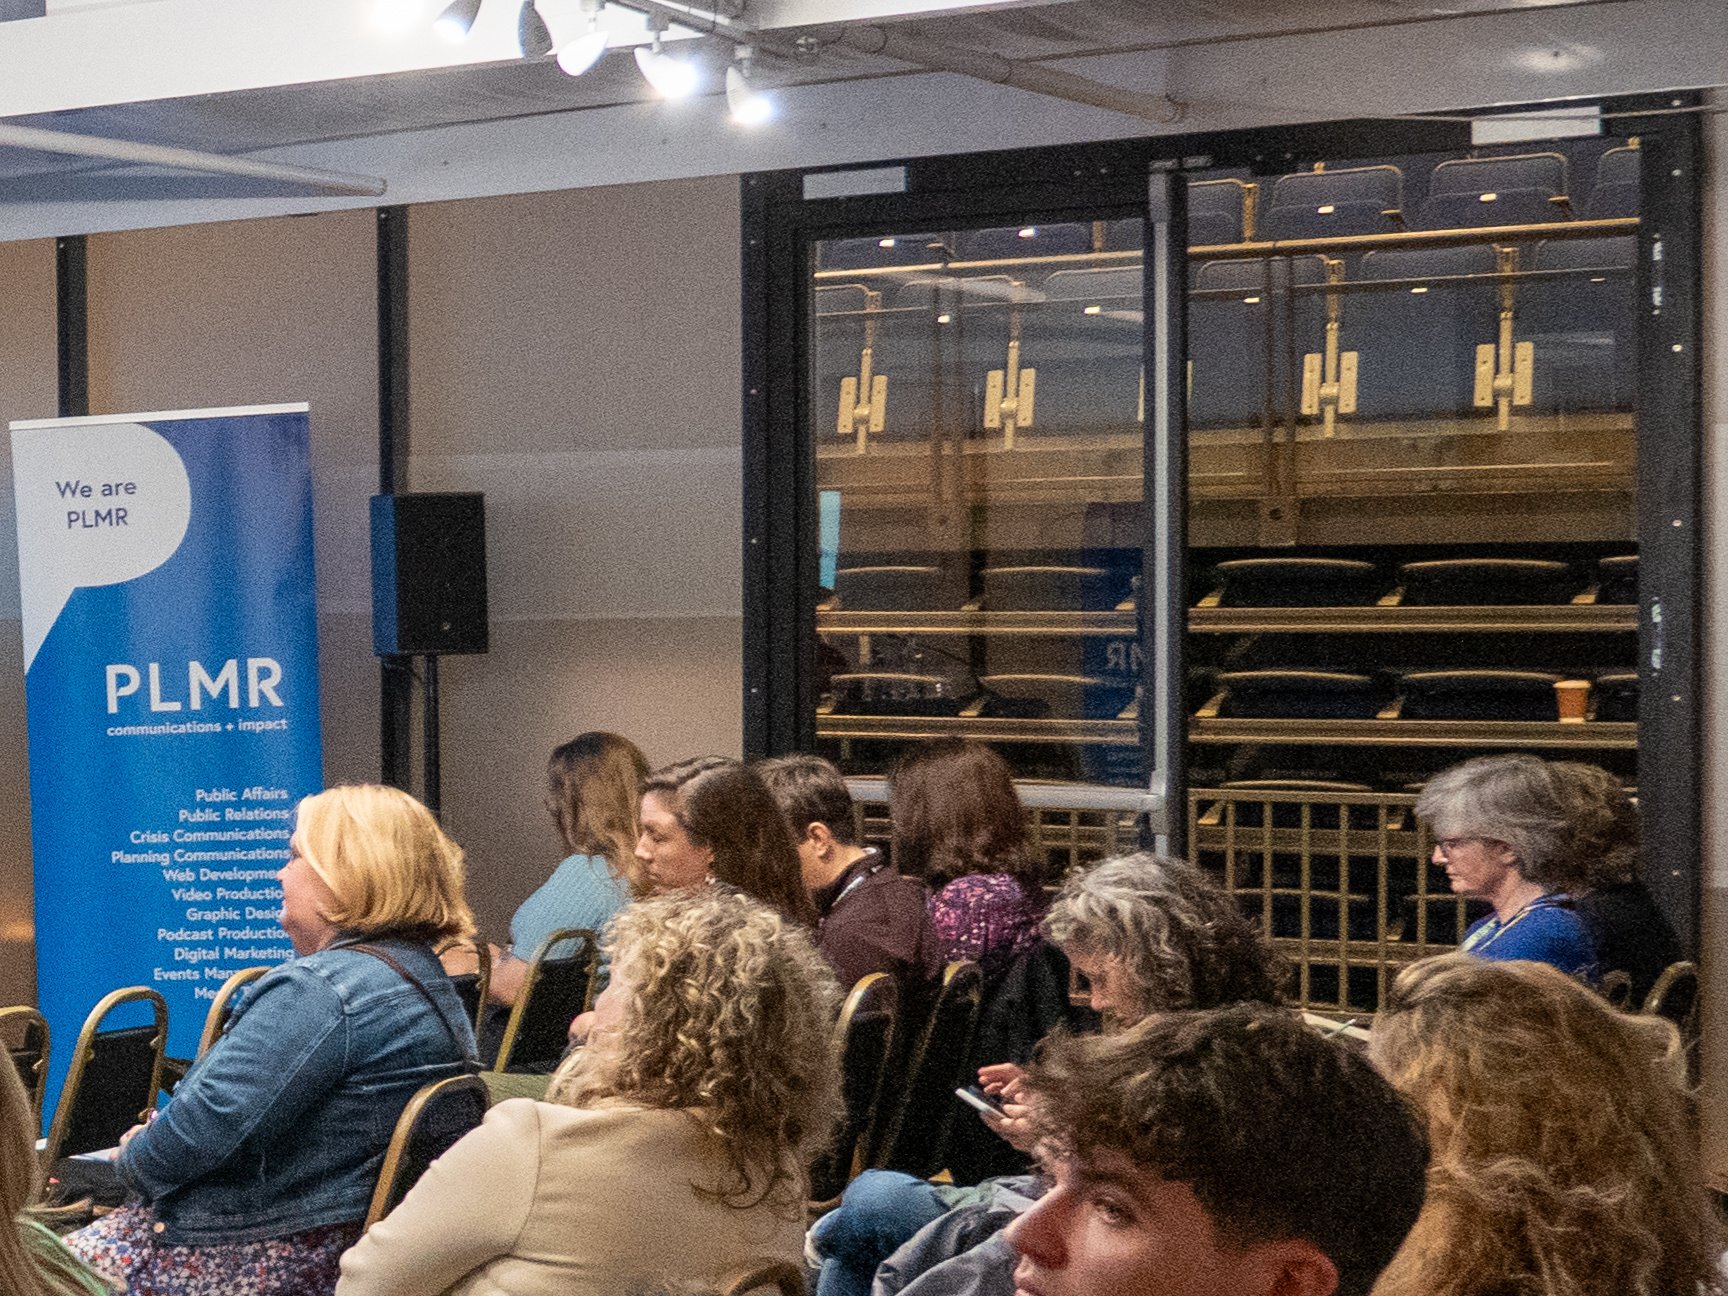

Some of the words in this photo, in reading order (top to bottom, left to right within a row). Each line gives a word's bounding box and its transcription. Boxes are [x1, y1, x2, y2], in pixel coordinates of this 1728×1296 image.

[56, 481, 92, 498] We
[101, 482, 136, 497] are
[67, 508, 127, 528] PLMR
[106, 657, 284, 713] PLMR
[107, 721, 221, 736] communications
[226, 723, 234, 731] +
[239, 719, 288, 733] impact
[196, 788, 236, 802] Public
[241, 786, 289, 800] Affairs
[179, 809, 220, 822] Public
[225, 807, 290, 820] Relations
[130, 830, 169, 844] Crisis
[173, 828, 290, 842] Communications
[111, 851, 171, 866] Planning
[173, 847, 291, 863] Communications
[162, 869, 195, 882] Web
[171, 888, 212, 901] Video
[216, 887, 284, 901] Productio
[186, 907, 240, 923] Graphic
[157, 928, 214, 941] Podcast
[174, 947, 220, 964] Digital
[224, 947, 294, 962] Marketing
[153, 967, 200, 980] Events
